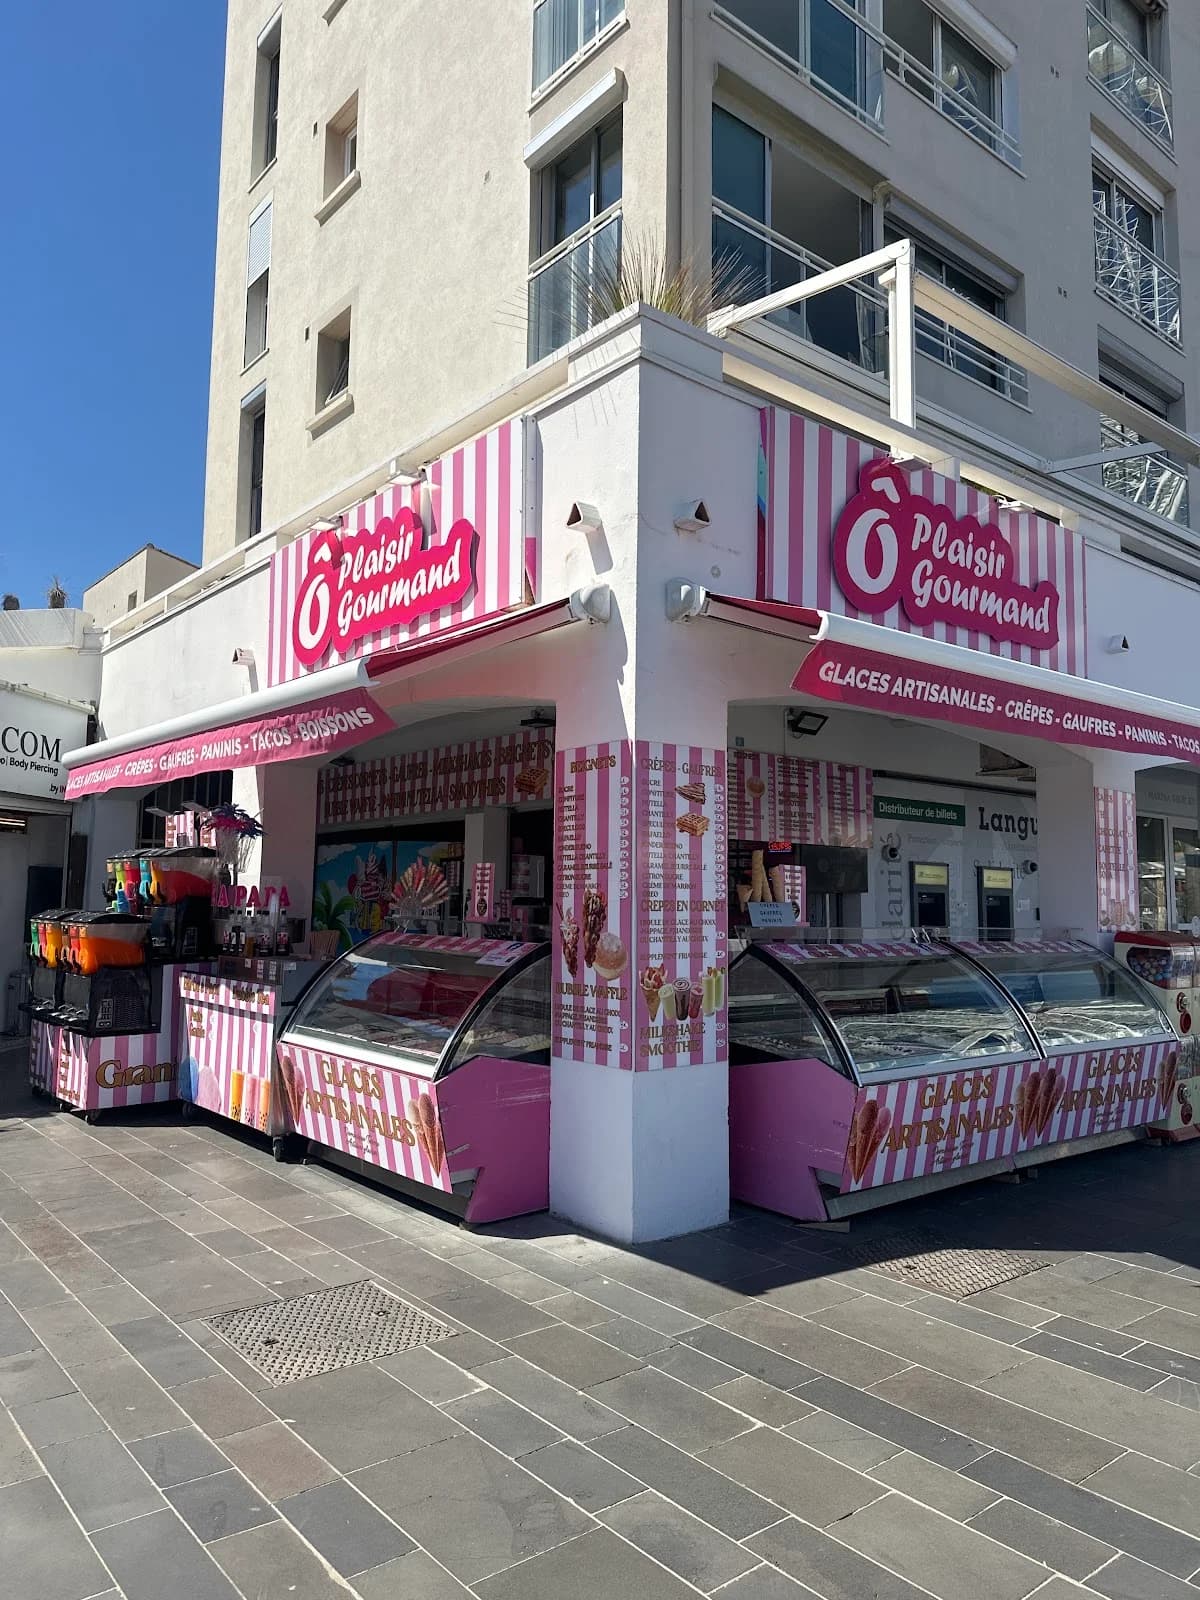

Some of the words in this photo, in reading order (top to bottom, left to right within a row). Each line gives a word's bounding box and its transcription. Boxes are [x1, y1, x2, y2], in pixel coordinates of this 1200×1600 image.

[846, 476, 899, 595] Ô
[911, 513, 1006, 580] Plaisir
[338, 525, 415, 589] Plaisir
[299, 544, 331, 651] Ô
[337, 541, 462, 637] Gourmand
[911, 558, 1051, 634] Gourmand
[819, 661, 891, 694] GLACES
[890, 676, 996, 715] ARTISANALES
[1004, 698, 1054, 727] CRÊPES
[1062, 711, 1117, 739] GAUFRES
[1124, 724, 1168, 747] PANINIS
[1171, 734, 1200, 756] TACOS
[124, 757, 154, 776] CRÊPES
[159, 747, 195, 770] GAUFRES
[199, 737, 242, 762] PANINIS
[250, 728, 292, 752] TACOS
[297, 706, 375, 742] BOISSONS
[9, 757, 29, 771] Body
[30, 761, 59, 777] Piercing
[570, 755, 616, 773] BEIGNETS
[682, 762, 722, 778] GAUFRES
[879, 802, 925, 817] Distributeur
[925, 806, 935, 818] de
[935, 808, 958, 820] billets
[676, 901, 688, 911] EN
[640, 1022, 706, 1040] MILKSHAKE
[640, 1040, 701, 1057] SMOOTHIE
[319, 1059, 384, 1101] GLACES
[1086, 1052, 1143, 1078] GLACES
[919, 1073, 996, 1111] GLACES
[1056, 1077, 1158, 1115] ARTISANALES
[304, 1087, 417, 1147] ARTISANALES
[881, 1103, 1016, 1155] ARTISANALES
